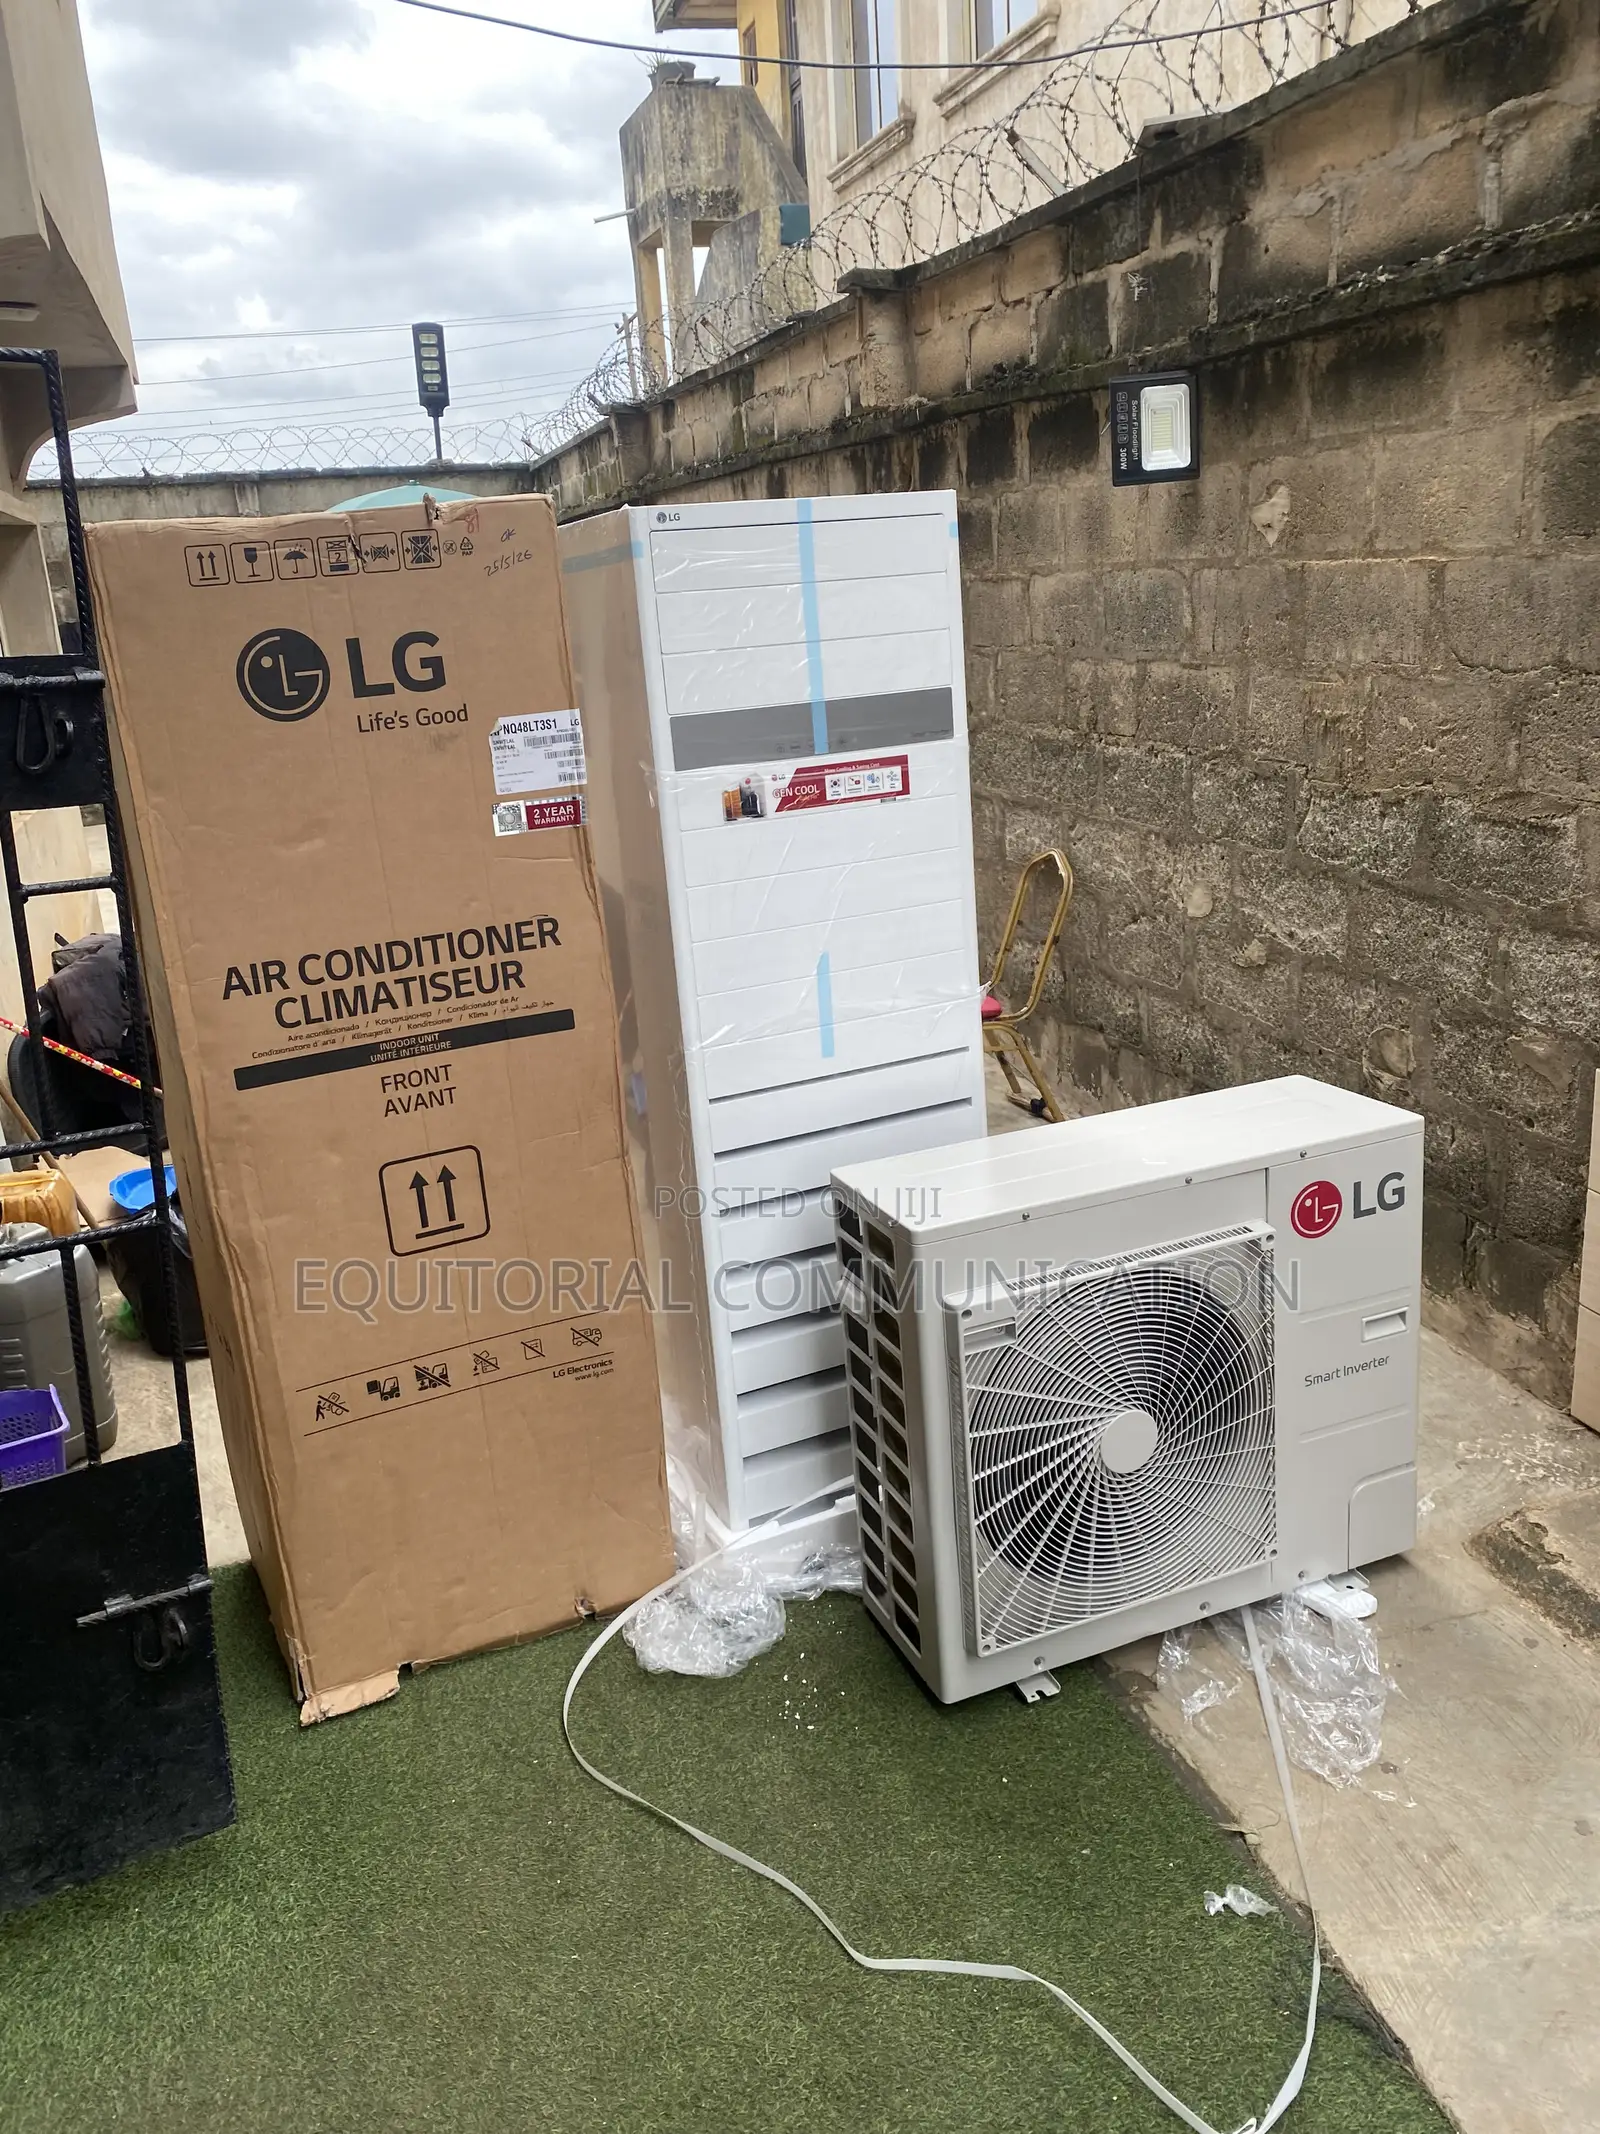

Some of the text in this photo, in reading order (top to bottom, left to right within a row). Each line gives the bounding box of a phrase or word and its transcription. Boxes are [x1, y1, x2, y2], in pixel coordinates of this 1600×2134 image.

[1120, 447, 1128, 470] 300W
[668, 512, 681, 522] LG
[500, 528, 516, 543] OK
[345, 630, 447, 698] LG
[356, 703, 469, 733] Life's Good
[490, 718, 558, 737] PNQ48LT3S1
[570, 718, 580, 727] LG
[772, 785, 793, 800] GEN
[793, 783, 821, 797] COOL
[533, 804, 575, 819] 2 YEAR
[534, 814, 575, 826] WARRANTY
[222, 916, 563, 1001] AIR CONDITIONER
[274, 960, 526, 1029] CLIMATISEUR
[287, 1034, 304, 1042] Aire
[305, 1023, 361, 1039] acondicionado
[446, 999, 498, 1014] Condicionador
[499, 997, 509, 1005] de
[510, 995, 520, 1003] Ar
[468, 1010, 489, 1020] Klima
[370, 1041, 452, 1063] UNITÉ INTÉRIEURE
[379, 1032, 440, 1051] INDOOR UNIT
[380, 1063, 453, 1094] FRONT
[383, 1086, 458, 1118] AVANT
[1353, 1171, 1406, 1220] LG
[552, 1359, 613, 1379] LG Electronics
[574, 1367, 615, 1381] www.lg.com
[1304, 1355, 1390, 1388] Smart Inverter
